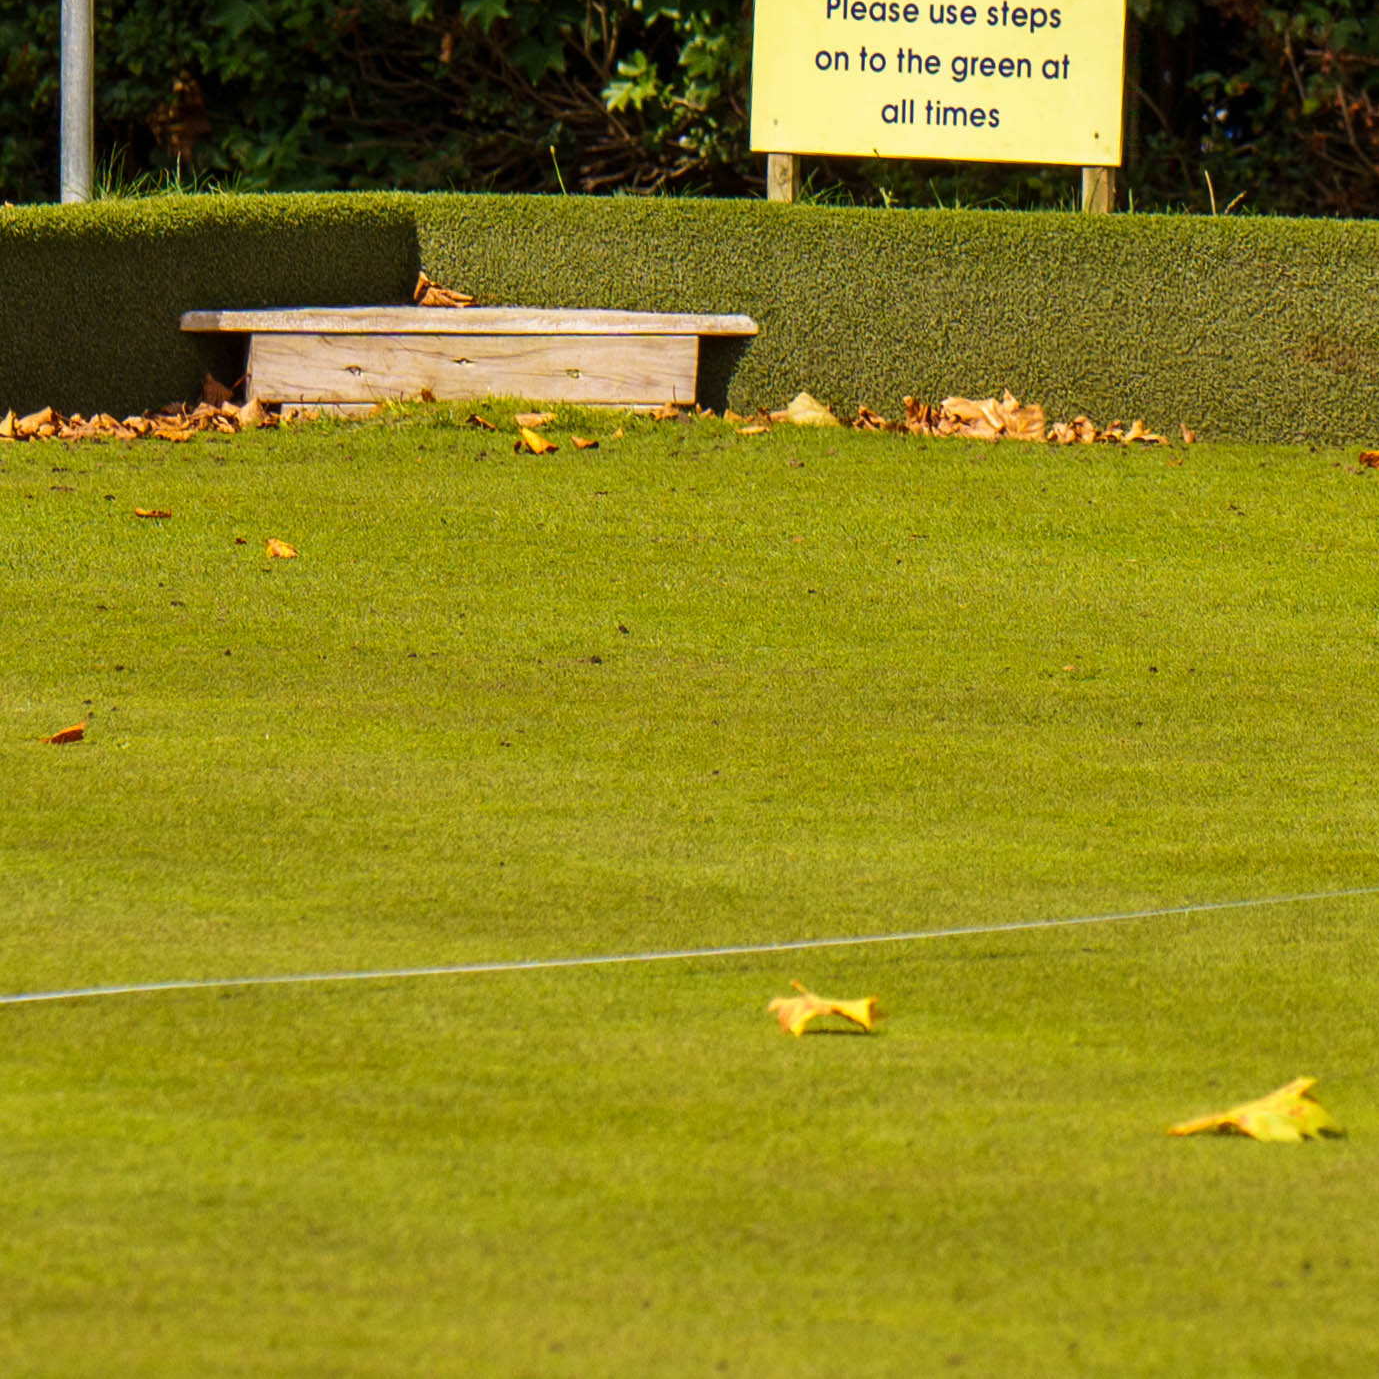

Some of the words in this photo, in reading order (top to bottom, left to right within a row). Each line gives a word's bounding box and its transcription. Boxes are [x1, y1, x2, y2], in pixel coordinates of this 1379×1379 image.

[929, 4, 977, 26] use
[987, 0, 1062, 34] steps
[815, 50, 850, 71] on
[859, 46, 887, 73] to
[897, 47, 941, 75] the
[951, 56, 1032, 83] green
[1041, 54, 1070, 80] at
[881, 99, 915, 125] all
[925, 100, 1000, 129] times
